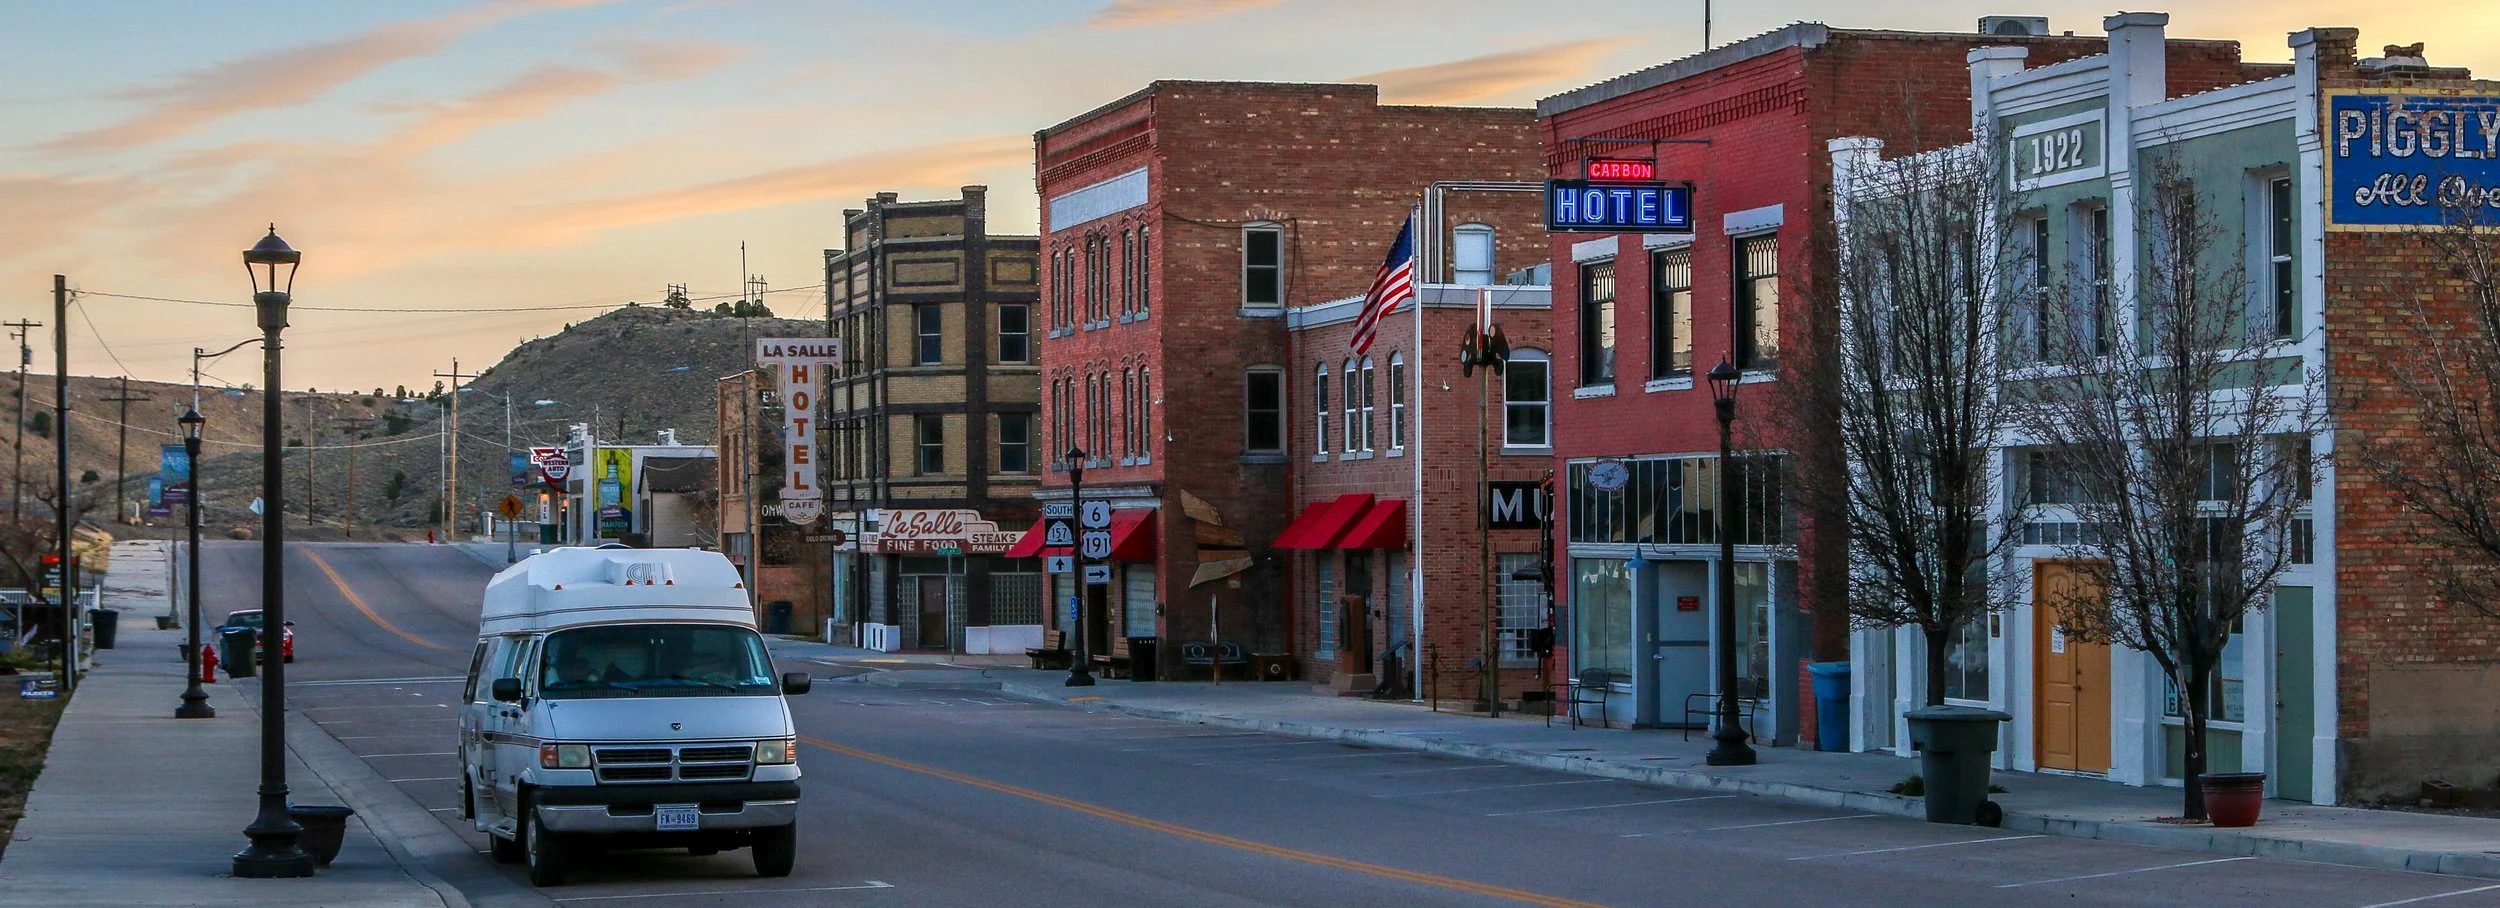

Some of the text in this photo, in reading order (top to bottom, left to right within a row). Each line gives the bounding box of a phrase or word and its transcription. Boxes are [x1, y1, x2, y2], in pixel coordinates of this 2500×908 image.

[2339, 108, 2500, 159] PIGGLY
[2031, 129, 2083, 175] 1922
[1590, 163, 1652, 178] CARBON
[2354, 173, 2428, 207] All
[1556, 188, 1684, 224] HOTEL
[763, 345, 837, 357] LA SALLE
[792, 364, 809, 490] HOTEL
[1046, 504, 1073, 515] SOUTH
[1091, 506, 1101, 522] 6
[972, 533, 1017, 544] STEAKS
[1052, 528, 1067, 539] 157
[886, 540, 916, 551] FINE
[923, 540, 958, 551] FOOD
[972, 544, 1005, 552] FAMILY
[1085, 537, 1108, 554] 191
